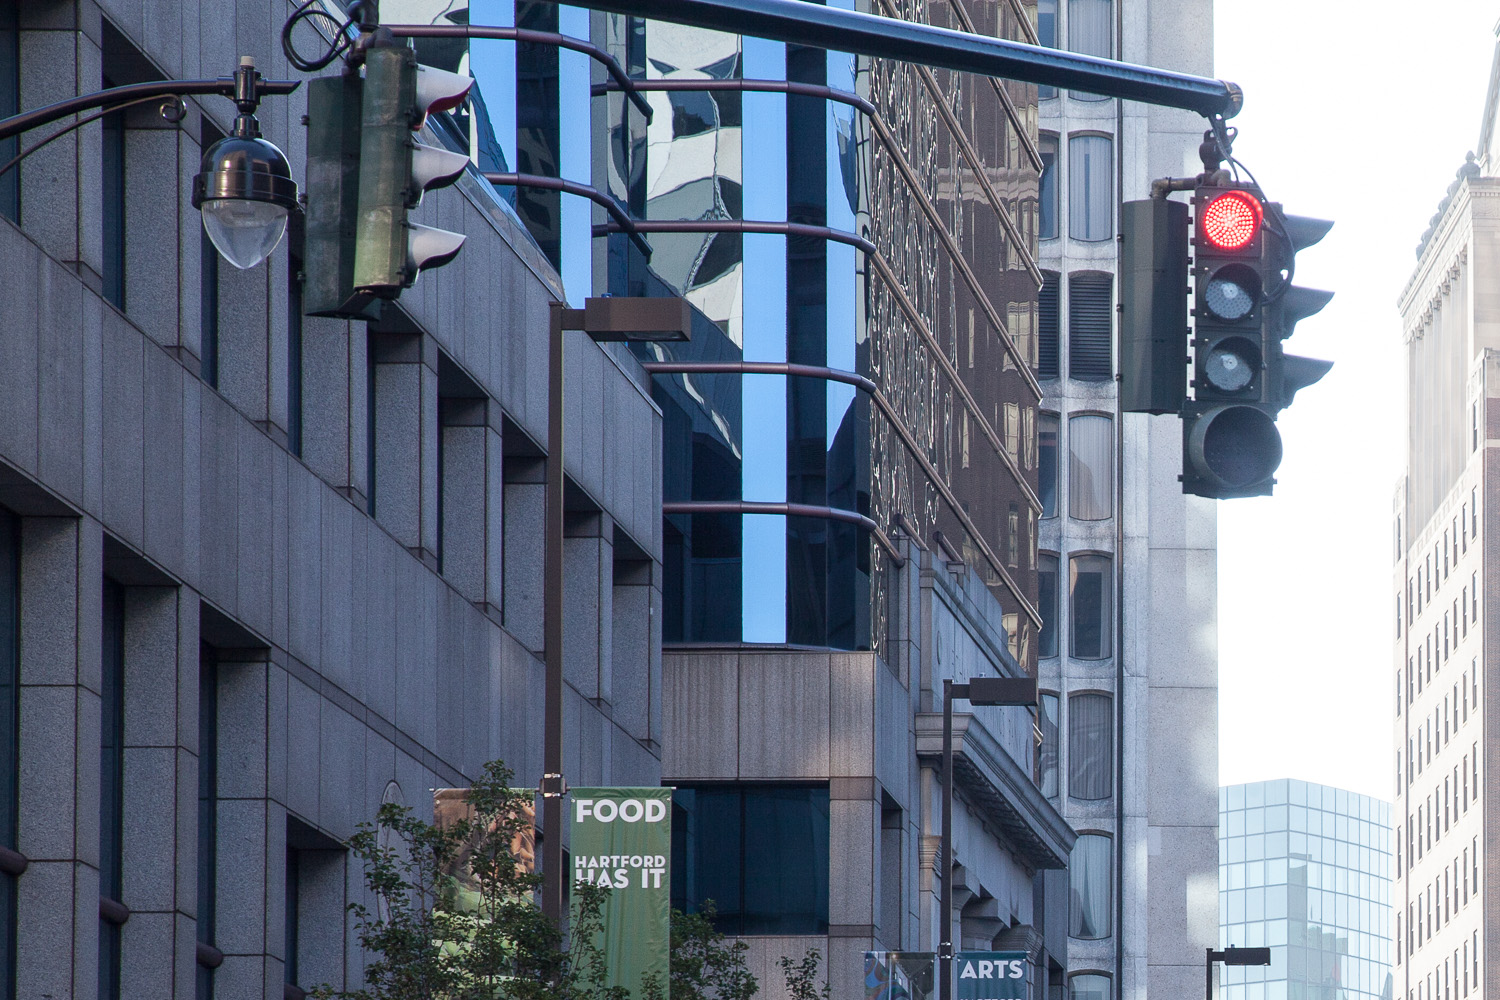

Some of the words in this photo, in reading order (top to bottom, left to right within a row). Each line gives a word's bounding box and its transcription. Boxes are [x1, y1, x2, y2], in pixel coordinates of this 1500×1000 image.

[576, 799, 667, 823] FOOD
[575, 855, 666, 868] HARTFORD
[575, 868, 630, 889] HAS
[641, 868, 666, 889] IT
[960, 960, 1024, 979] ARTS
